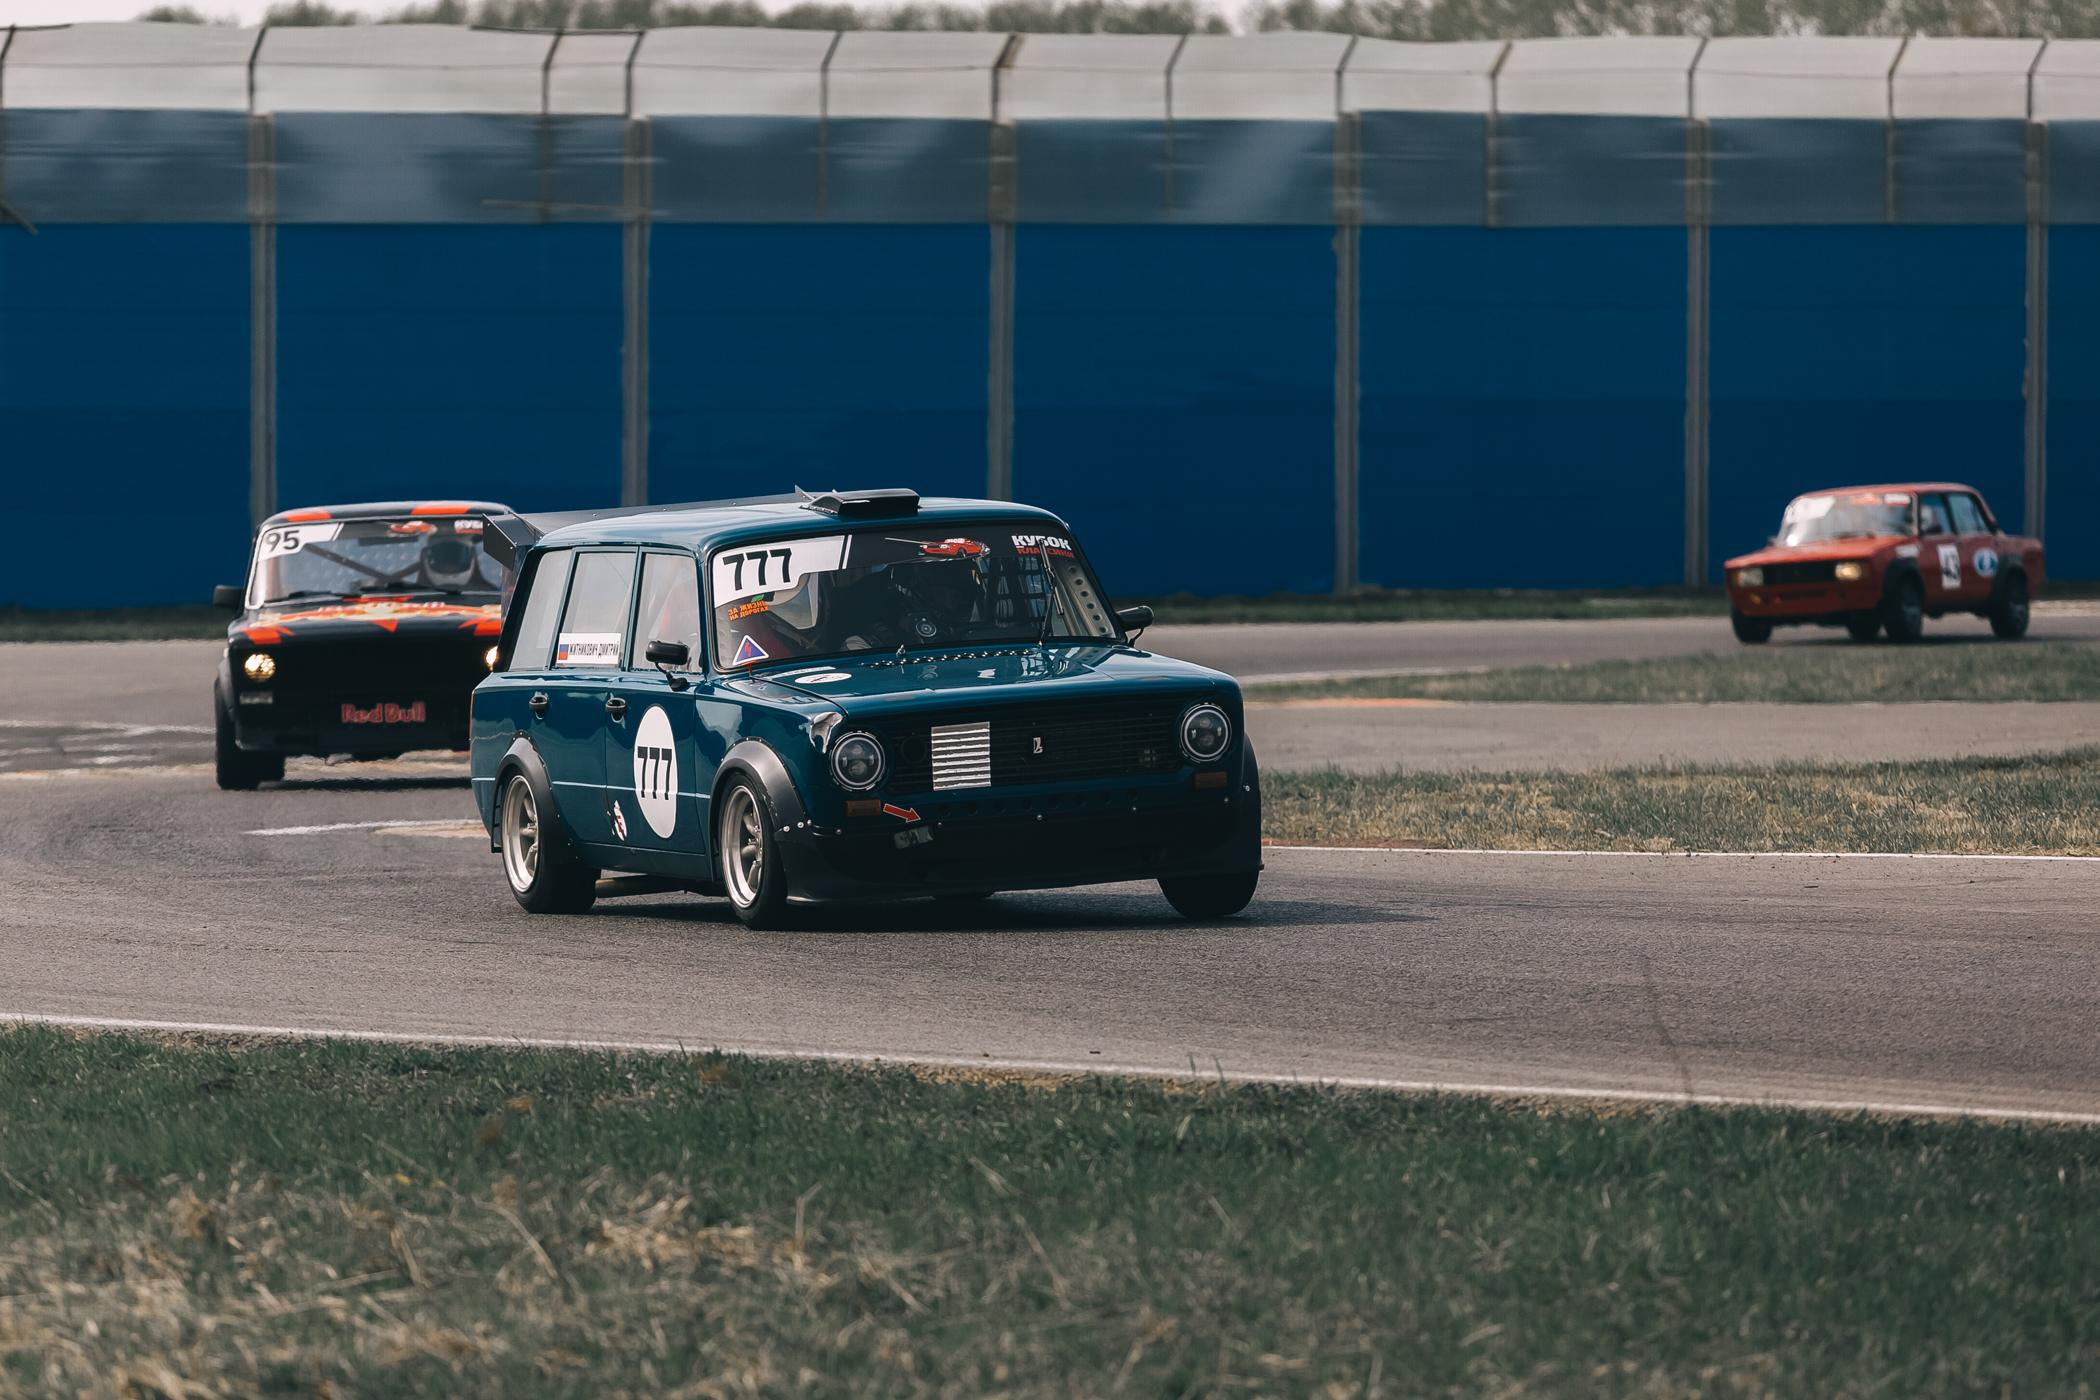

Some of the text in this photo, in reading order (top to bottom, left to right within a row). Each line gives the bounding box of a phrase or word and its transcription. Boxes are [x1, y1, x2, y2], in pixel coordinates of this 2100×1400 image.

[266, 530, 300, 553] 95
[1011, 535, 1072, 551] КУБОК
[722, 547, 792, 591] 777
[342, 701, 426, 723] Red Bull
[637, 746, 673, 800] 777
